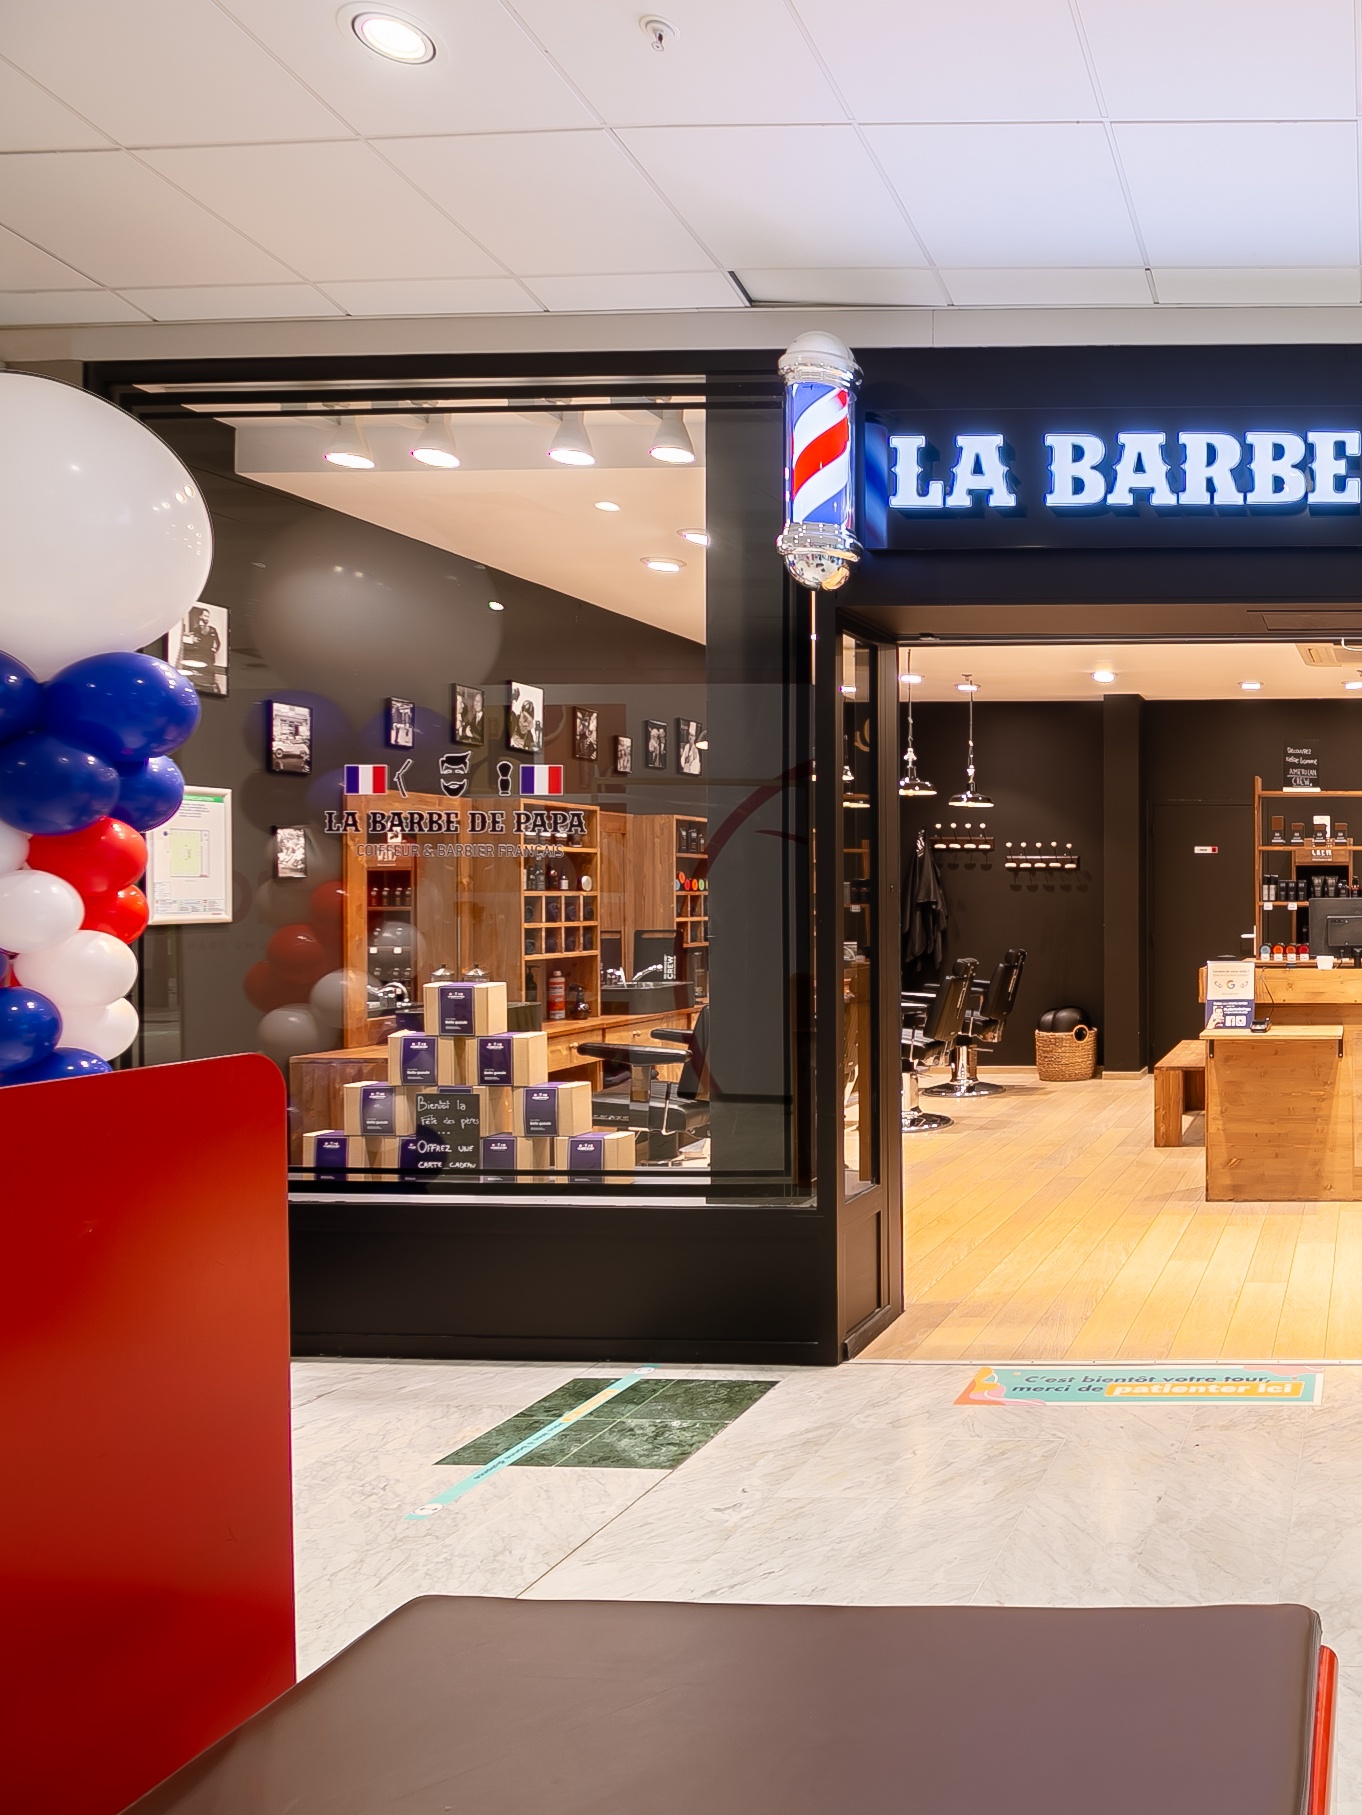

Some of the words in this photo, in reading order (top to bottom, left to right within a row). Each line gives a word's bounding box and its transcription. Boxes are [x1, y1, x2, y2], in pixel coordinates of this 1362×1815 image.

[886, 430, 1010, 509] LA
[324, 810, 361, 833] LA
[368, 810, 459, 833] BARBE
[467, 810, 505, 833] DE
[513, 810, 587, 834] PAPA
[357, 844, 421, 857] COIFFEUR
[424, 844, 435, 857] &
[438, 844, 495, 858] BARBIER
[498, 844, 564, 860] FRANÇAIS
[456, 1100, 467, 1111] la
[1025, 1375, 1077, 1384] C'est
[1082, 1373, 1157, 1384] bientôt
[1162, 1376, 1217, 1384] votre
[1223, 1375, 1272, 1384] tour,
[1011, 1385, 1070, 1393] merci
[1077, 1384, 1105, 1393] de
[1111, 1383, 1254, 1396] patienter
[1257, 1382, 1293, 1394] ici
